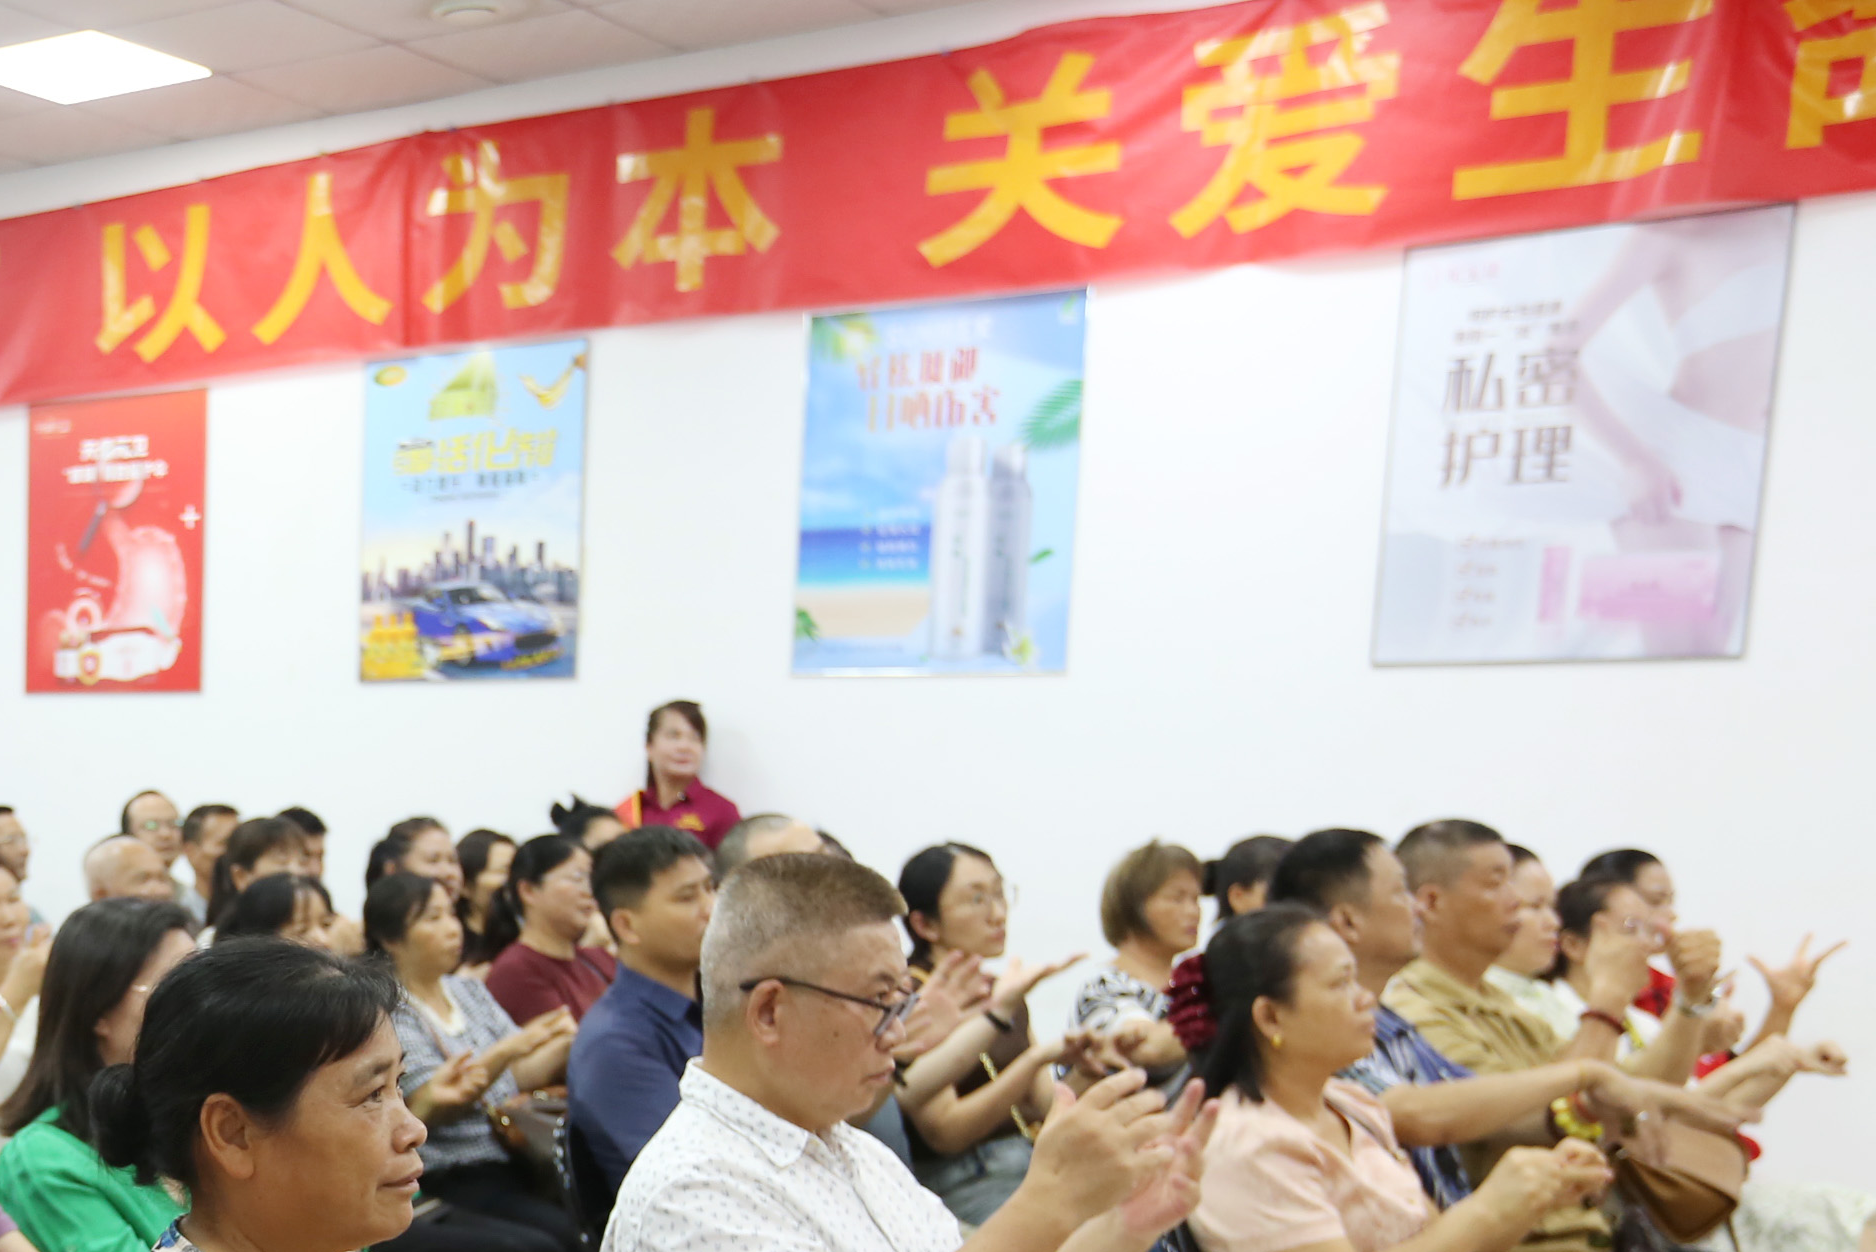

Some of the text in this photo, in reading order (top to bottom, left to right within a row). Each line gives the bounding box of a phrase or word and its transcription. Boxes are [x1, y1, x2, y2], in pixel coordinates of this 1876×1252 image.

[93, 106, 783, 363] 以人为本
[918, 0, 1876, 268] 关爱生
[1440, 425, 1572, 488] 护理
